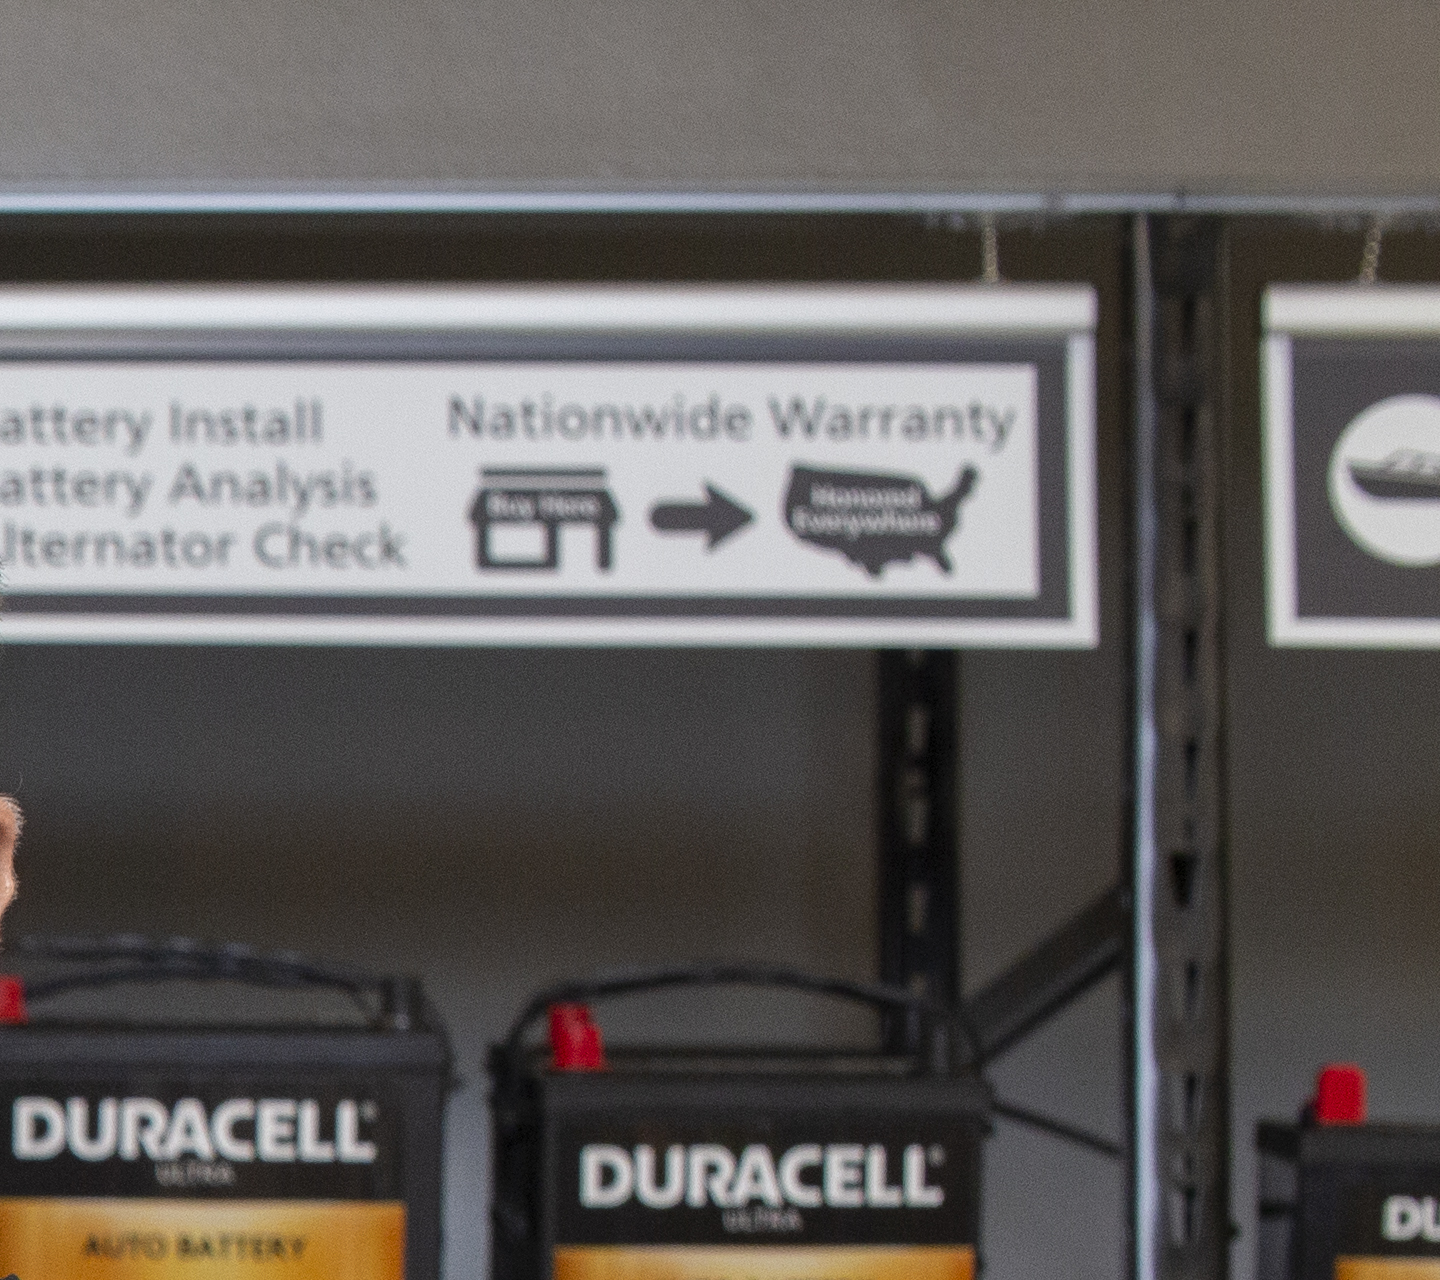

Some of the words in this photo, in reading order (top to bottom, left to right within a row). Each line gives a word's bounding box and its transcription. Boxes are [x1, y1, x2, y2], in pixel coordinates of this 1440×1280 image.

[169, 397, 324, 444] Install
[448, 393, 753, 441] Nationwide
[768, 396, 1015, 451] Warranty
[168, 460, 379, 518] Analysis
[0, 523, 237, 569] lternator
[252, 521, 407, 569] Check
[12, 1096, 377, 1163] DURACELL
[579, 1144, 944, 1209] DURACELL
[84, 1231, 168, 1261] AUTO
[176, 1231, 309, 1261] BATTERY
